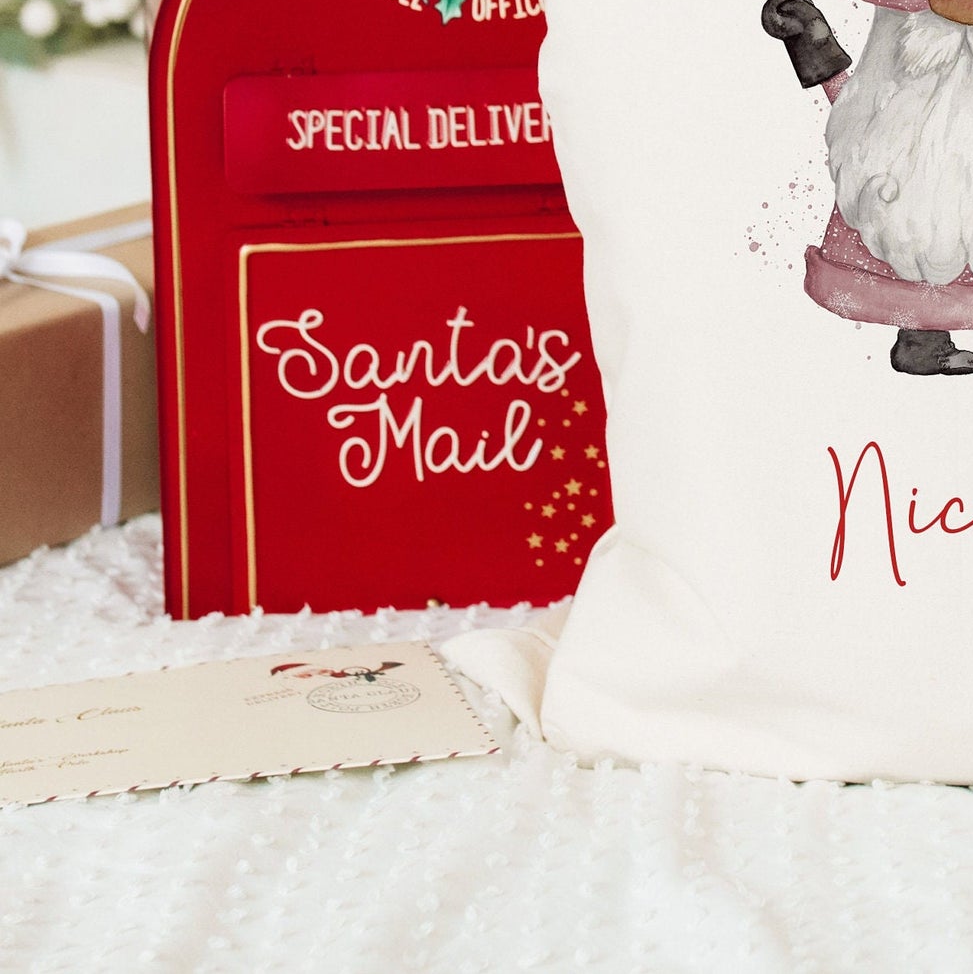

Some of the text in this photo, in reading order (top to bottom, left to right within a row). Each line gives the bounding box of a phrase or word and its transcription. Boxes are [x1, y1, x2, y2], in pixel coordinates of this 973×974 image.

[286, 109, 421, 151] SPECIAL
[256, 305, 582, 400] Santa's
[327, 392, 543, 488] Mail
